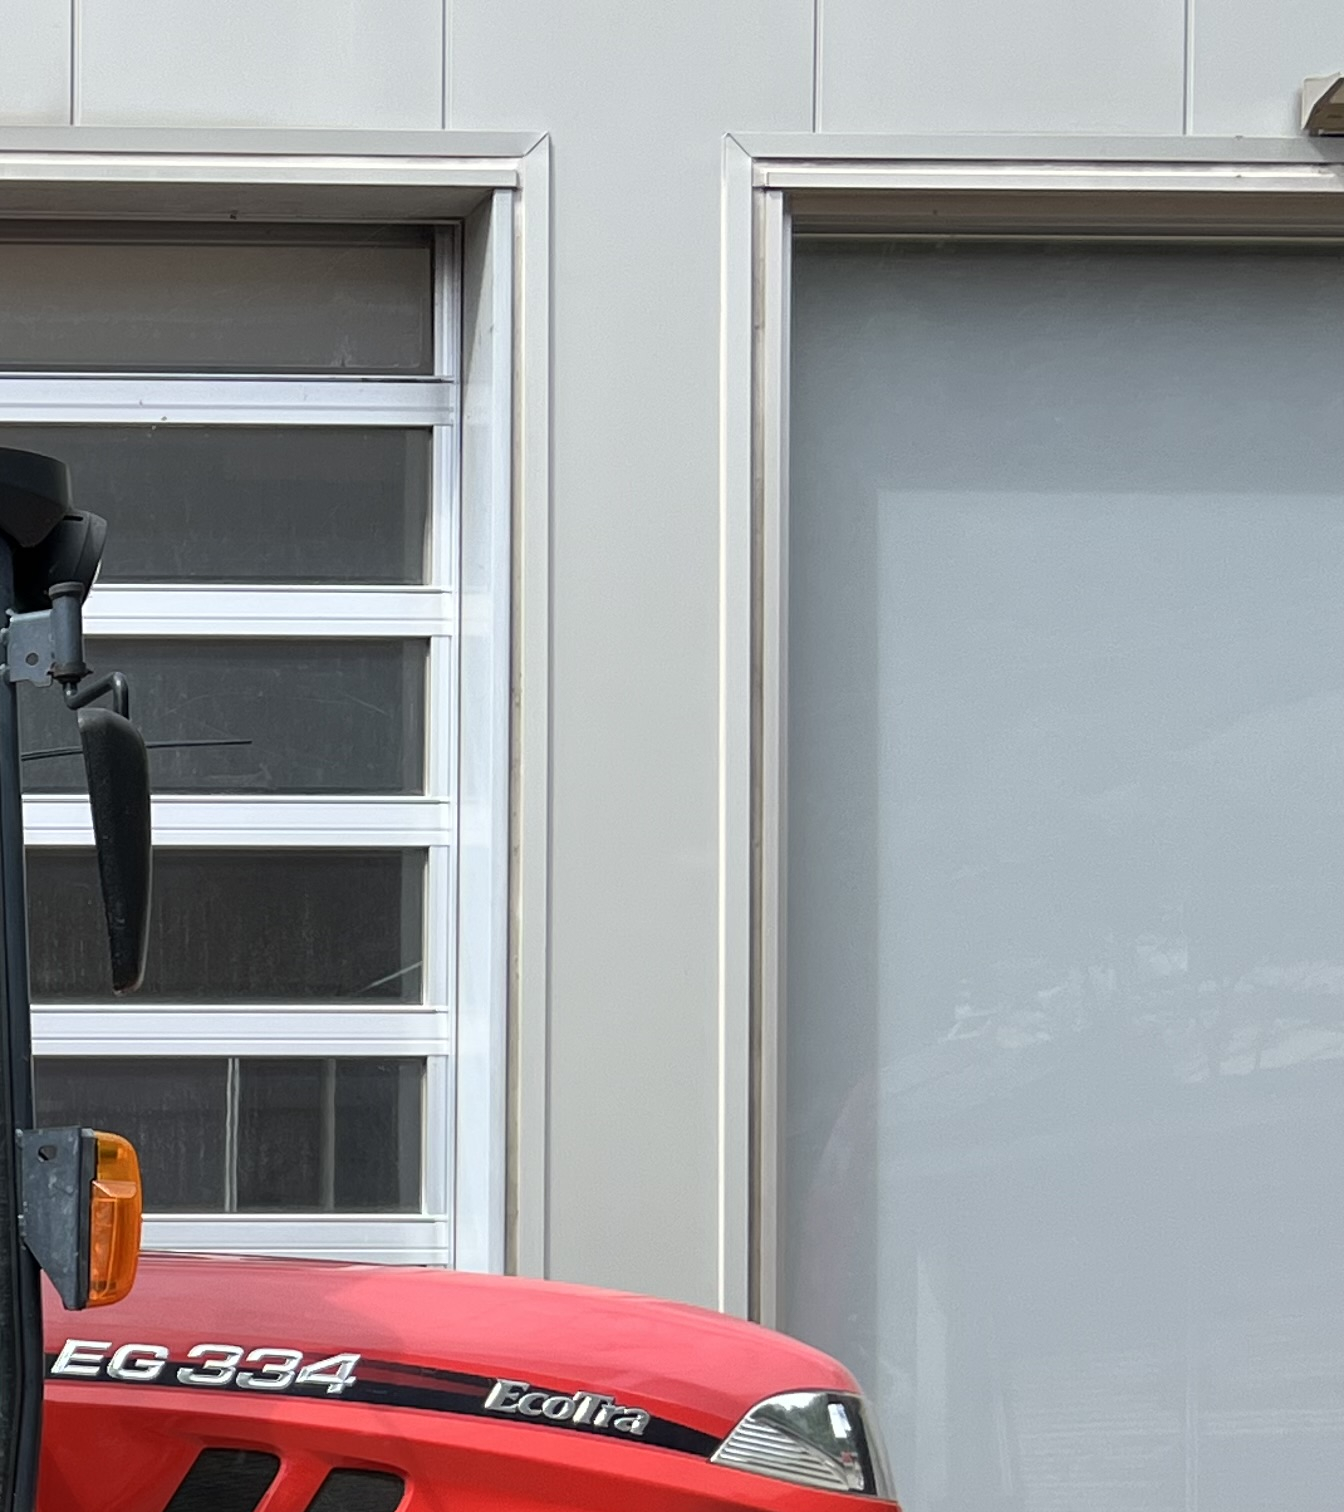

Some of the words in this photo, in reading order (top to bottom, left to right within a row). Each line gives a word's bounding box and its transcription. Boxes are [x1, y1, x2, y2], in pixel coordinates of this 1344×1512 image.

[50, 1338, 169, 1381] EG
[176, 1343, 361, 1395] 334
[484, 1378, 650, 1436] EcoTra
